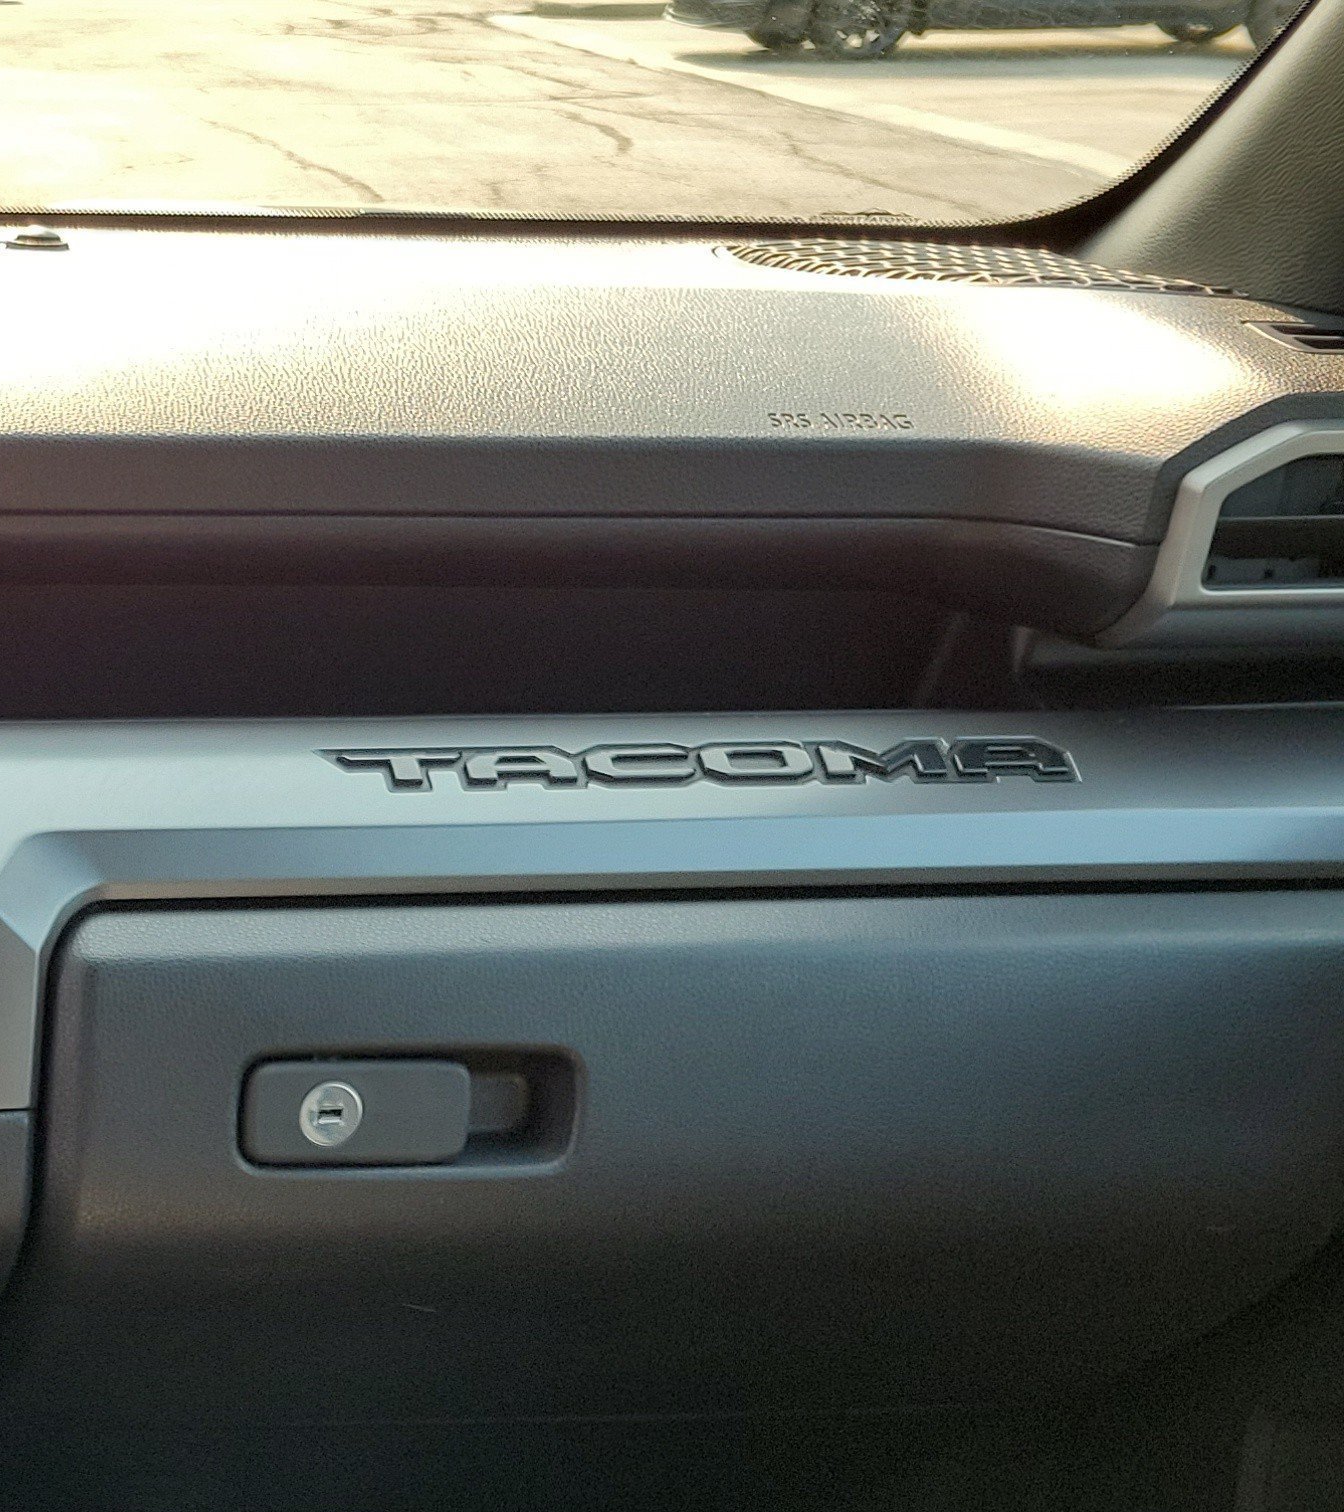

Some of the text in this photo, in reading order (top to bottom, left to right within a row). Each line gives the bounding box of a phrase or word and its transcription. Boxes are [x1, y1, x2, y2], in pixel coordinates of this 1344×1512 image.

[767, 412, 914, 430] SRS AIRBAG
[313, 736, 1081, 793] TACOMA
